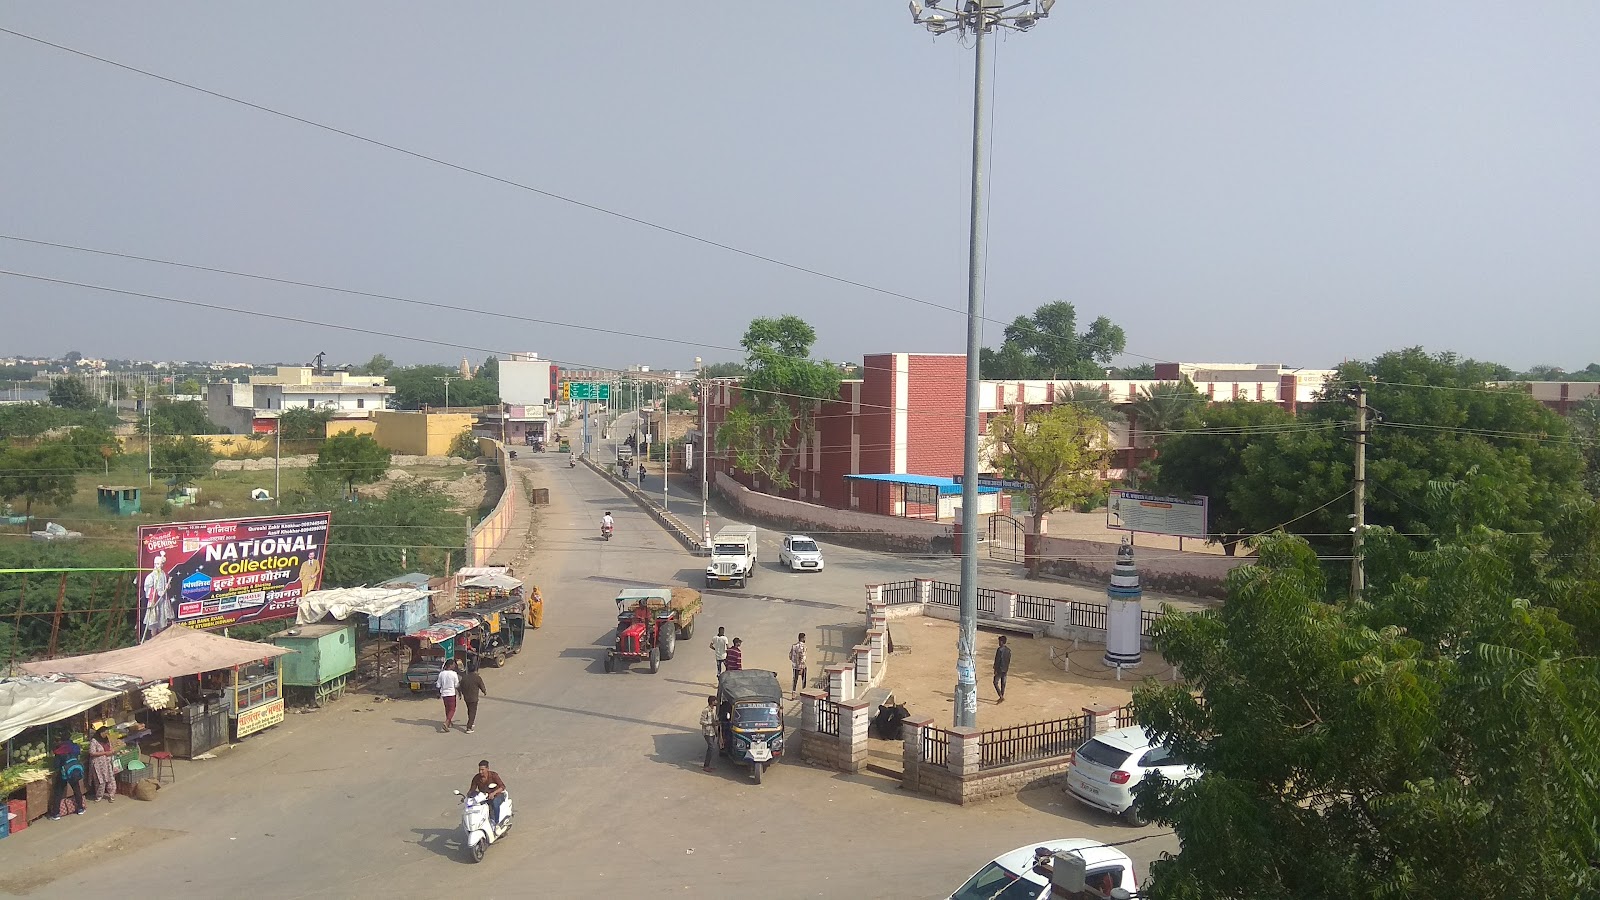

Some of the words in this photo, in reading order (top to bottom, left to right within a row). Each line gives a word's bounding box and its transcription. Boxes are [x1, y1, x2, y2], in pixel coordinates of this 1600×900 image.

[206, 524, 237, 534] शनिवार
[205, 534, 318, 562] NATIONAL
[219, 556, 299, 576] Collection
[213, 575, 236, 592] दूल्हे
[236, 574, 260, 585] राजा
